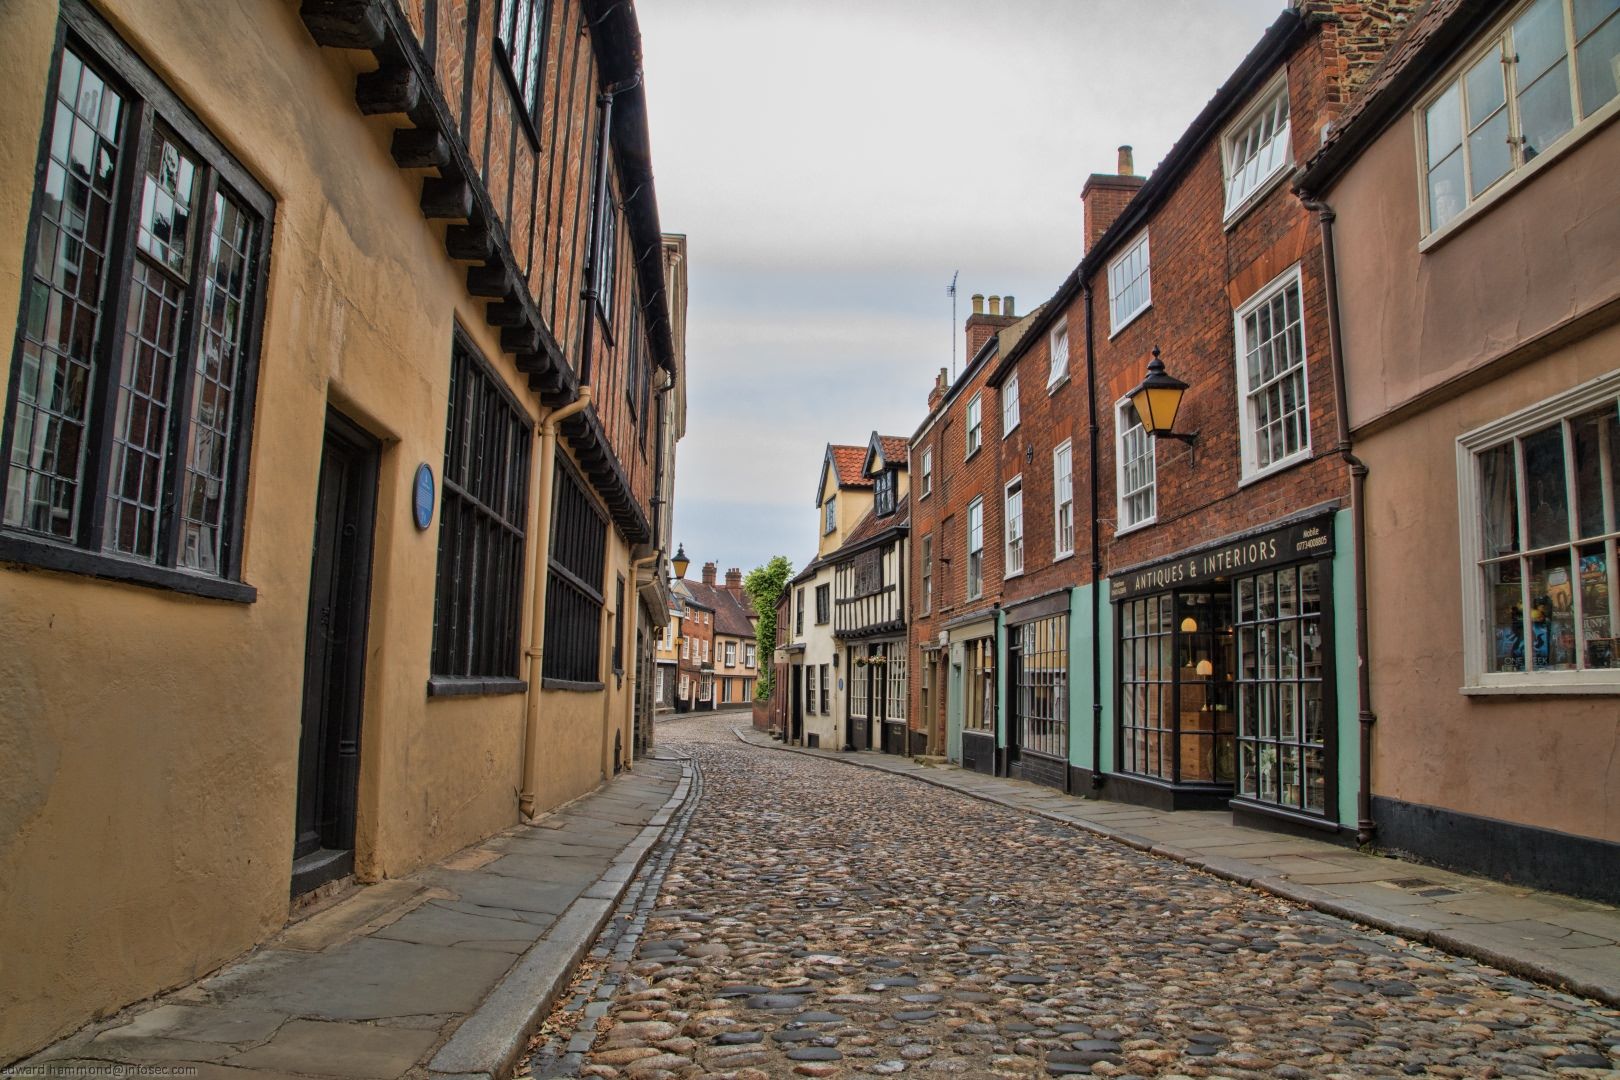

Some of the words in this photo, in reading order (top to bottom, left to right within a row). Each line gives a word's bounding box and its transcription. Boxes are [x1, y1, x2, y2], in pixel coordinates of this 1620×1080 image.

[1302, 527, 1320, 539] Mobile
[1135, 564, 1184, 591] ANTIQUES
[1190, 561, 1197, 578] &
[1204, 538, 1277, 575] INTERIORS
